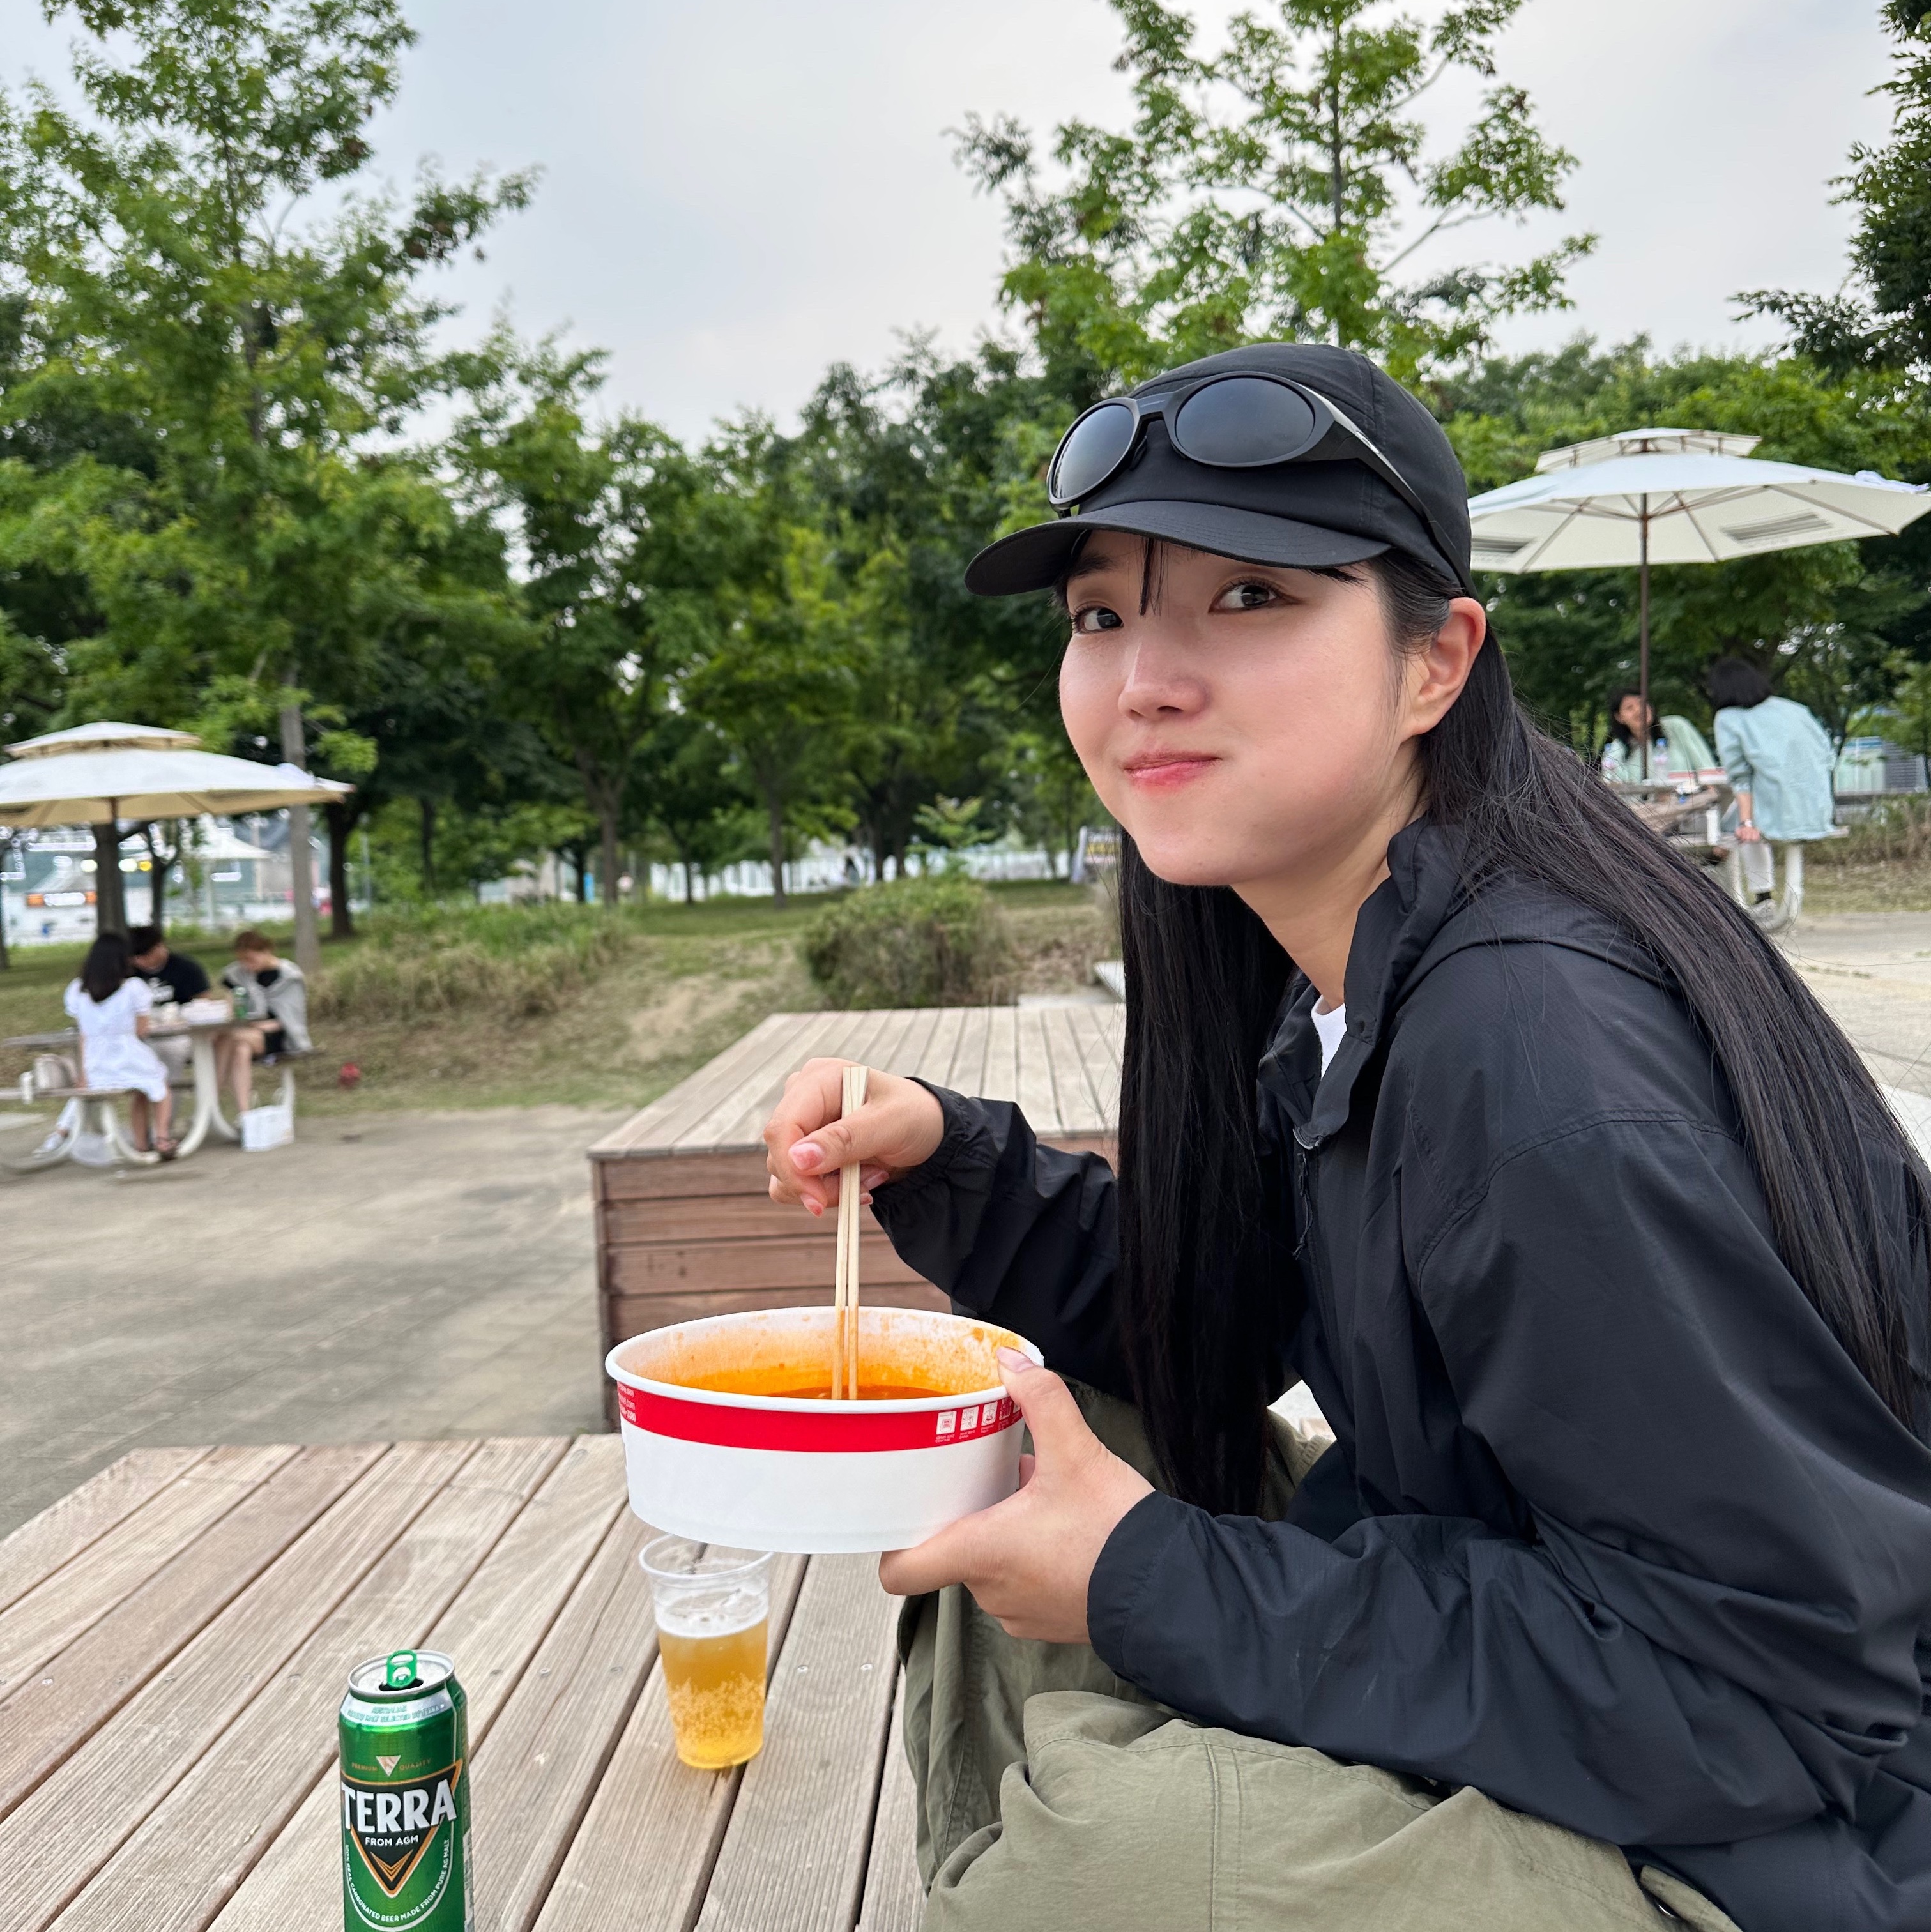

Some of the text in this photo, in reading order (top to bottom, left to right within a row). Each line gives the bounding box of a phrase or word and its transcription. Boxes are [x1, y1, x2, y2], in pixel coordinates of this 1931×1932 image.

[399, 1758, 431, 1771] QUALITY
[341, 1779, 457, 1832] TERRA
[365, 1834, 419, 1846] FROM AGM
[349, 1882, 381, 1920] CARBONATED
[400, 1905, 422, 1921] MADE
[420, 1889, 438, 1909] FROM
[434, 1869, 447, 1890] PURE
